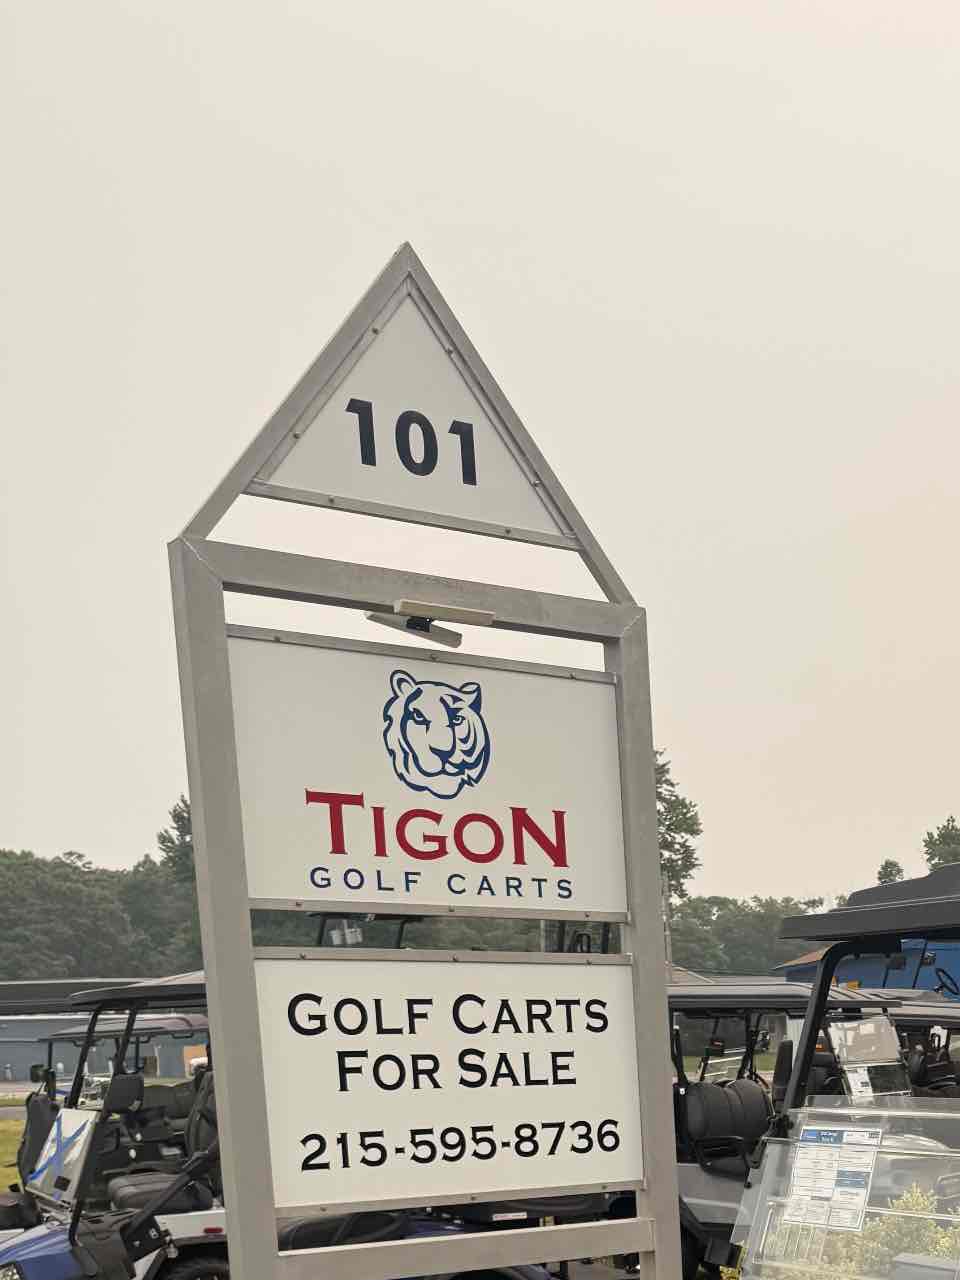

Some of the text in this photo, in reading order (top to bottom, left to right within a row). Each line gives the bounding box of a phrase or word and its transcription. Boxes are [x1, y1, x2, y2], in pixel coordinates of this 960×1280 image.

[345, 397, 477, 486] 101
[305, 788, 568, 868] TIGON
[310, 866, 573, 899] GOLF CARTS
[288, 993, 609, 1036] GOLF CARTS
[336, 1048, 577, 1092] FOR SALE
[300, 1119, 620, 1171] 215-595-8736
